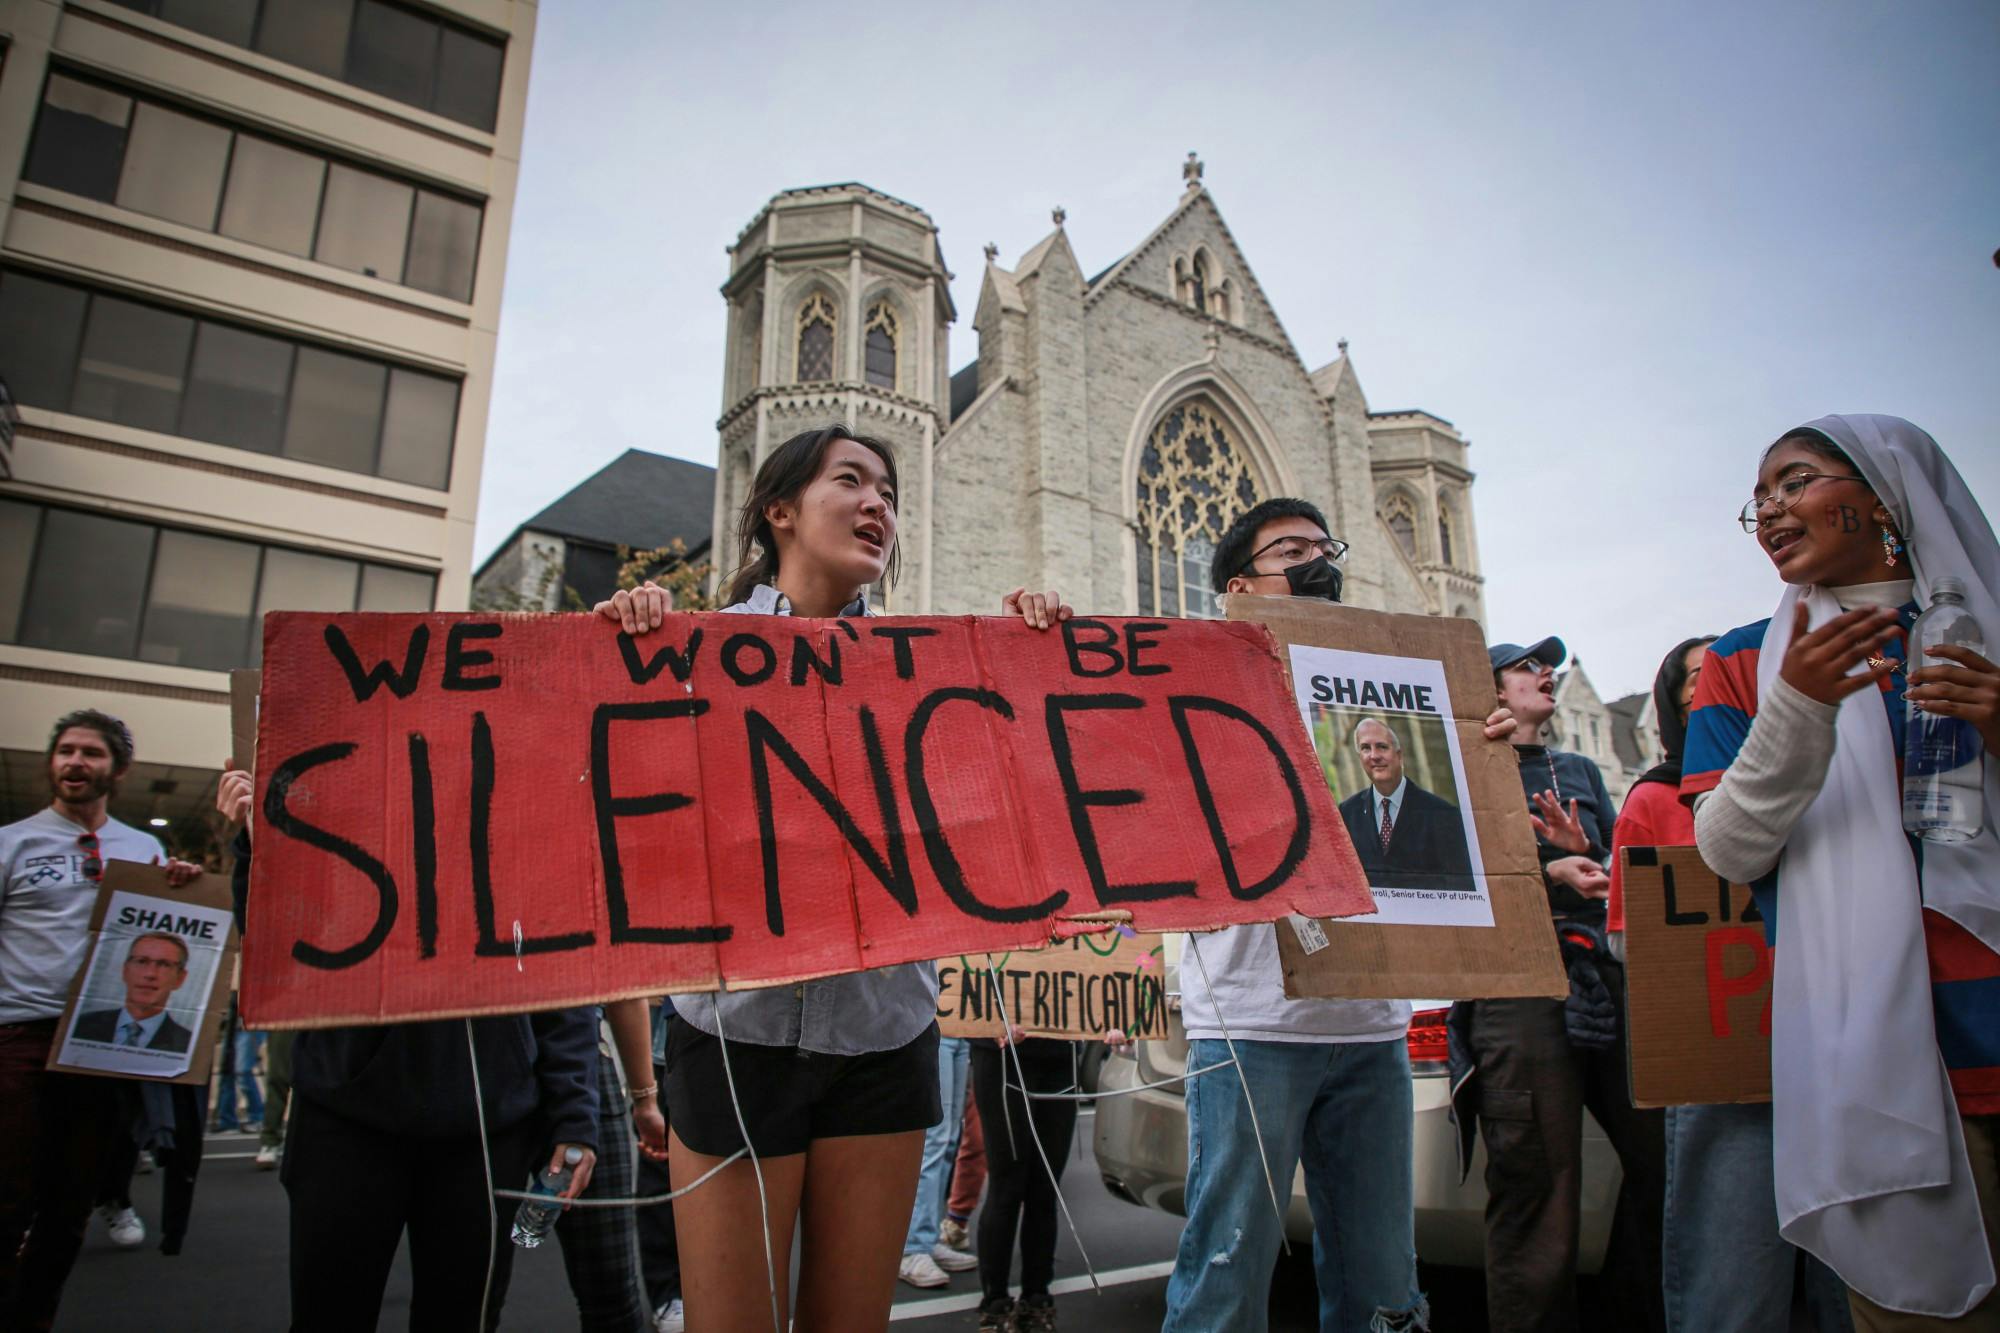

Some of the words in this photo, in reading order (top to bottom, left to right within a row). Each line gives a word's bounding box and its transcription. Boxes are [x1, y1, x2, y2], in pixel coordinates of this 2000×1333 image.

[324, 623, 503, 703] WE
[616, 620, 942, 686] WON'T
[1060, 619, 1172, 678] BE
[1310, 674, 1437, 712] SHAME
[262, 686, 1311, 971] SILENCED
[118, 906, 218, 940] SHAME
[1391, 889, 1415, 899] Senior
[1416, 891, 1436, 900] Exec.
[1437, 891, 1448, 900] VP
[1449, 891, 1457, 900] of
[1458, 892, 1486, 902] UPenn,
[935, 966, 1169, 1038] ENNTRIFICATION
